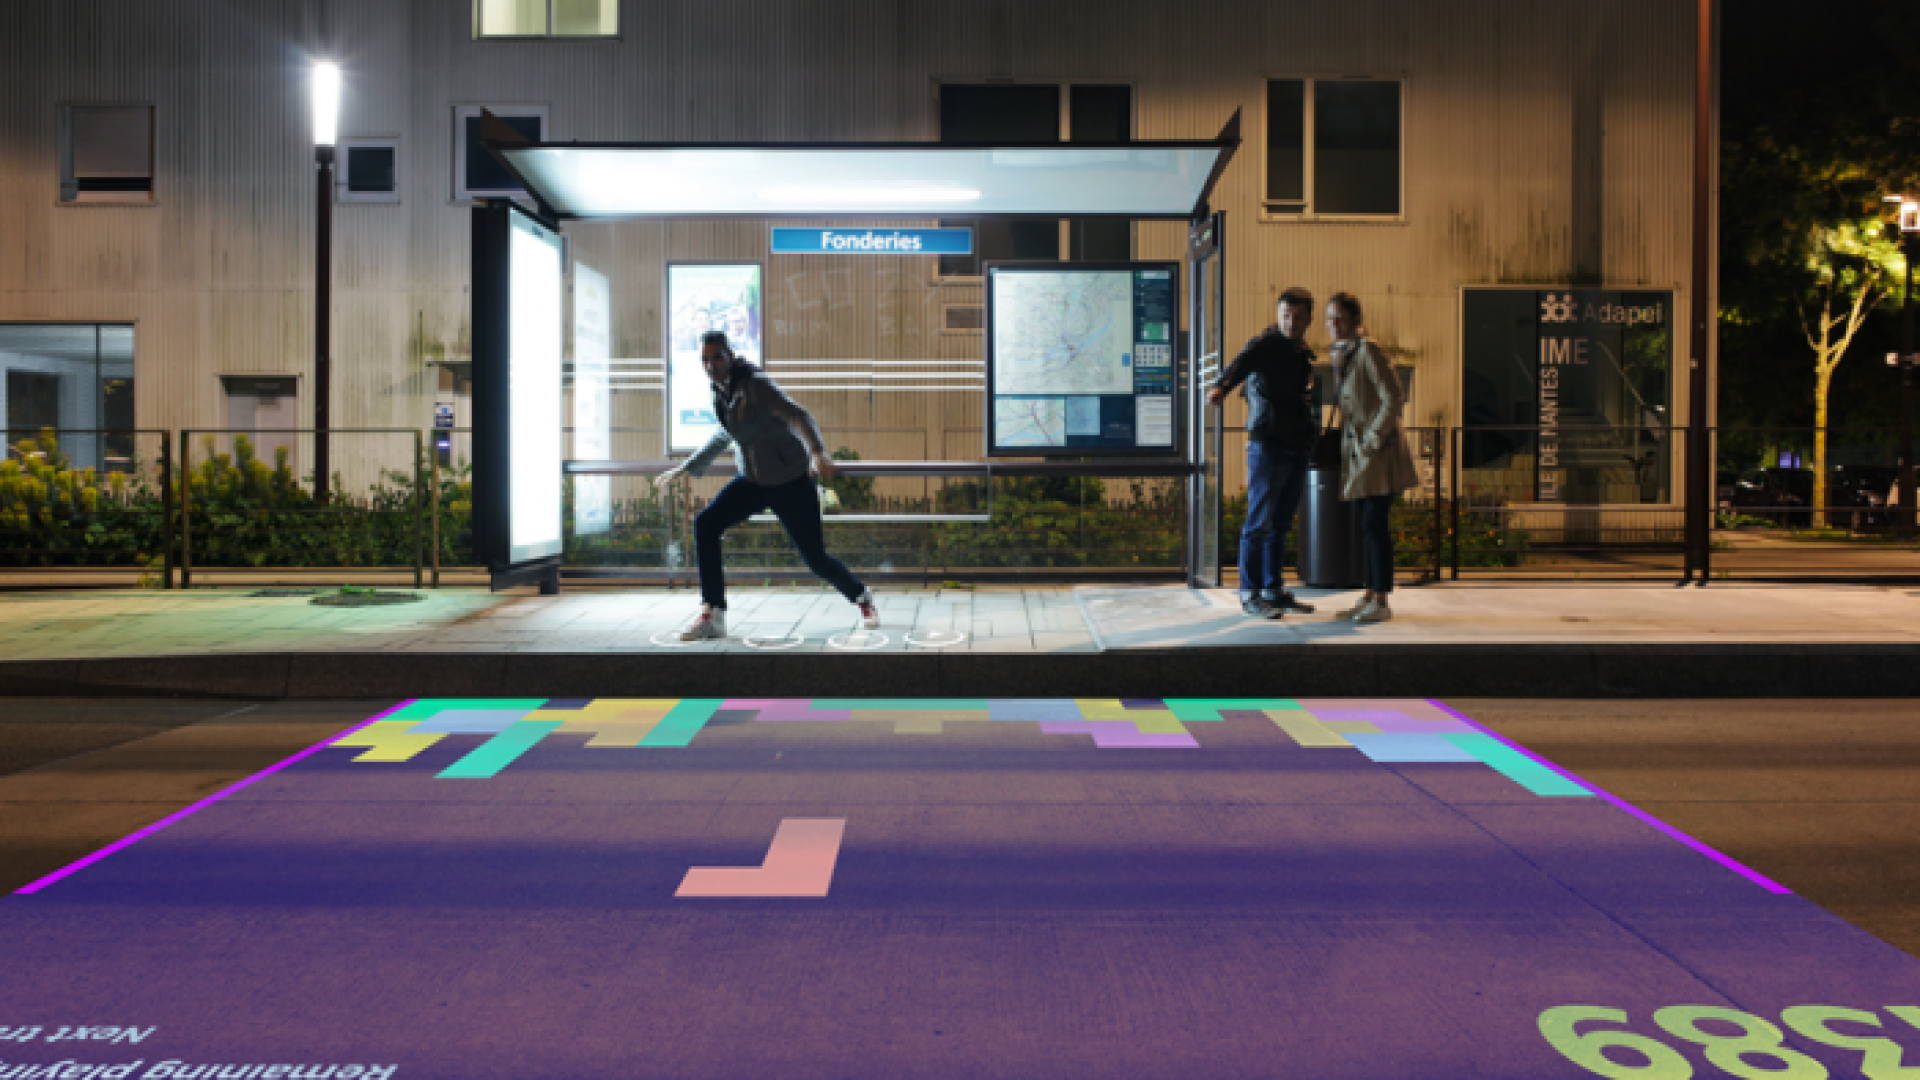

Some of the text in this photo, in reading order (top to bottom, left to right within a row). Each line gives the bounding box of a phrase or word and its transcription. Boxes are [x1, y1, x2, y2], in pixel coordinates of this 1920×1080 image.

[821, 231, 922, 250] Fonderies
[1583, 301, 1664, 328] Adapei
[1541, 336, 1589, 365] IME
[1540, 366, 1559, 436] NANTES
[1540, 443, 1559, 467] DE
[44, 1025, 158, 1044] Next
[0, 1058, 398, 1080] Remaining playin
